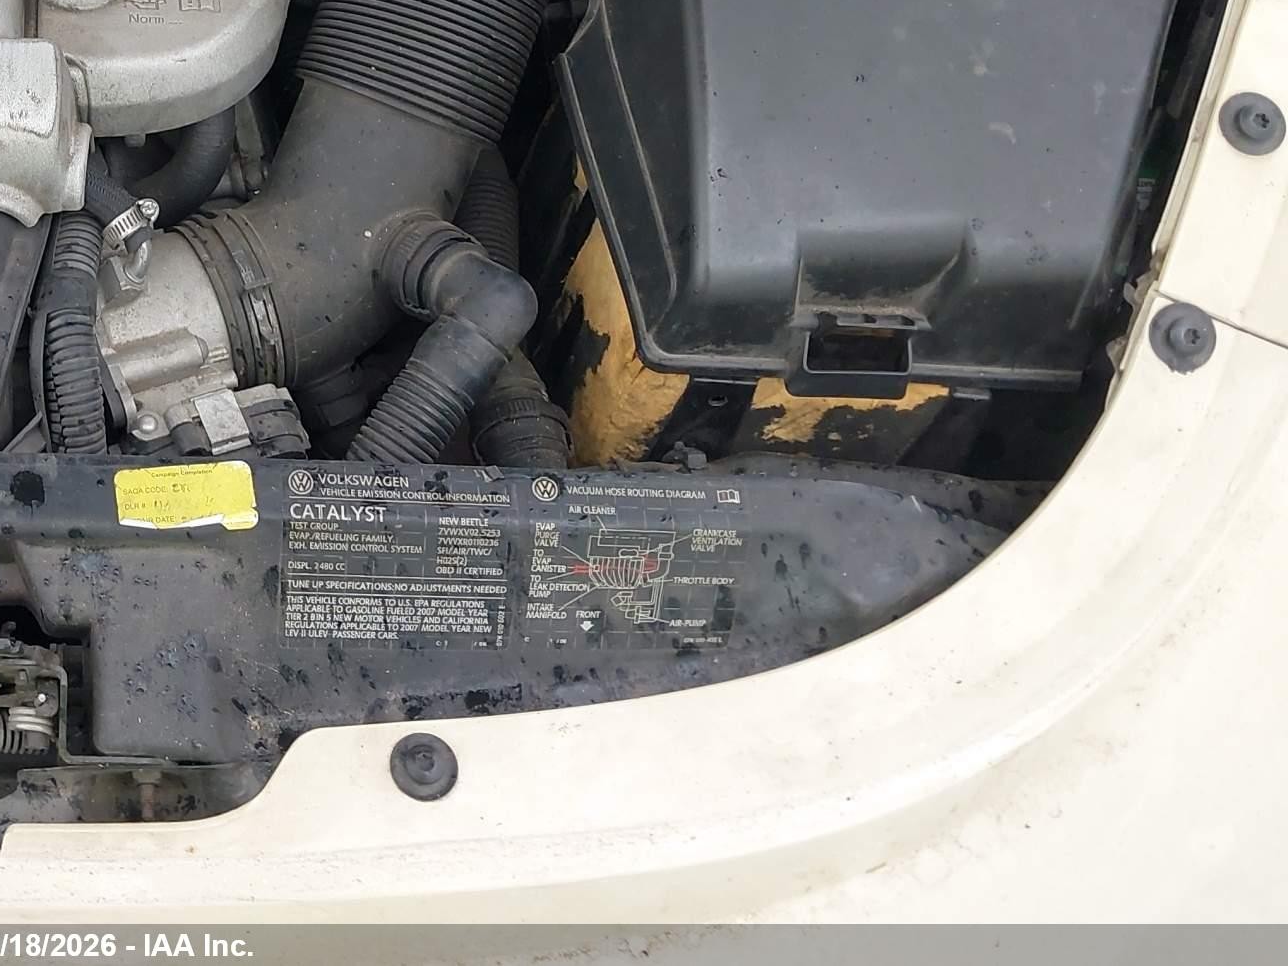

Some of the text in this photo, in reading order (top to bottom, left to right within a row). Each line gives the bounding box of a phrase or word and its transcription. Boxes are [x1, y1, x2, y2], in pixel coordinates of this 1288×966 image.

[128, 12, 165, 24] Norm
[318, 474, 409, 488] VOLKSWAGEN
[320, 488, 510, 503] VEHICLE EMISSION CONTROL INFORMATION
[566, 486, 706, 499] VACUUM HOSE ROUTING DIAGRAM
[290, 503, 386, 522] CATALYST
[583, 506, 616, 515] CLEANER
[310, 522, 339, 531] GROUP
[439, 518, 488, 526] NEW BEETLE
[535, 522, 556, 530] EVAP
[535, 532, 560, 540] PURGE
[693, 528, 736, 538] CRANKCASE
[534, 540, 559, 548] VALVE
[692, 537, 743, 546] VENTILATION
[310, 542, 348, 552] EMISSION
[350, 544, 388, 552] CONTROL
[390, 546, 423, 554] SYSTEM
[532, 549, 544, 557] TO
[288, 560, 312, 570] DISPL.
[335, 562, 346, 570] CC
[532, 557, 552, 565] EVAP
[464, 567, 504, 576] CERTIFIED
[531, 564, 566, 573] CANISTER
[530, 574, 542, 582] TO
[674, 576, 710, 584] THROTTLE
[288, 580, 310, 588] TUNE
[312, 580, 324, 588] UP
[410, 584, 472, 593] ADJUSTMENTS
[474, 586, 507, 594] NEEDED
[530, 582, 590, 592] LEAK DETECTION
[286, 596, 304, 604] THIS
[306, 596, 336, 604] VEHICLE
[338, 598, 382, 606] CONFORMS
[431, 600, 485, 609] REGULATIONS
[527, 602, 554, 612] INTAKE
[286, 604, 488, 617] APPLICABLE TO GASOLINE FUELED 2007 MODEL YEAR
[576, 610, 601, 618] FRONT
[286, 612, 302, 620] TIER
[334, 614, 352, 622] NEW
[354, 614, 384, 622] MOTOR
[386, 615, 422, 623] VEHICLES
[423, 616, 440, 624] AND
[442, 616, 488, 624] CALIFORNIA
[526, 611, 567, 620] MANIFOLD
[285, 621, 338, 630] REGULATIONS
[340, 622, 386, 630] APPLICABLE
[388, 623, 398, 631] TO
[421, 624, 448, 632] MODEL
[450, 624, 470, 632] YEAR
[332, 631, 376, 639] PASSENGER
